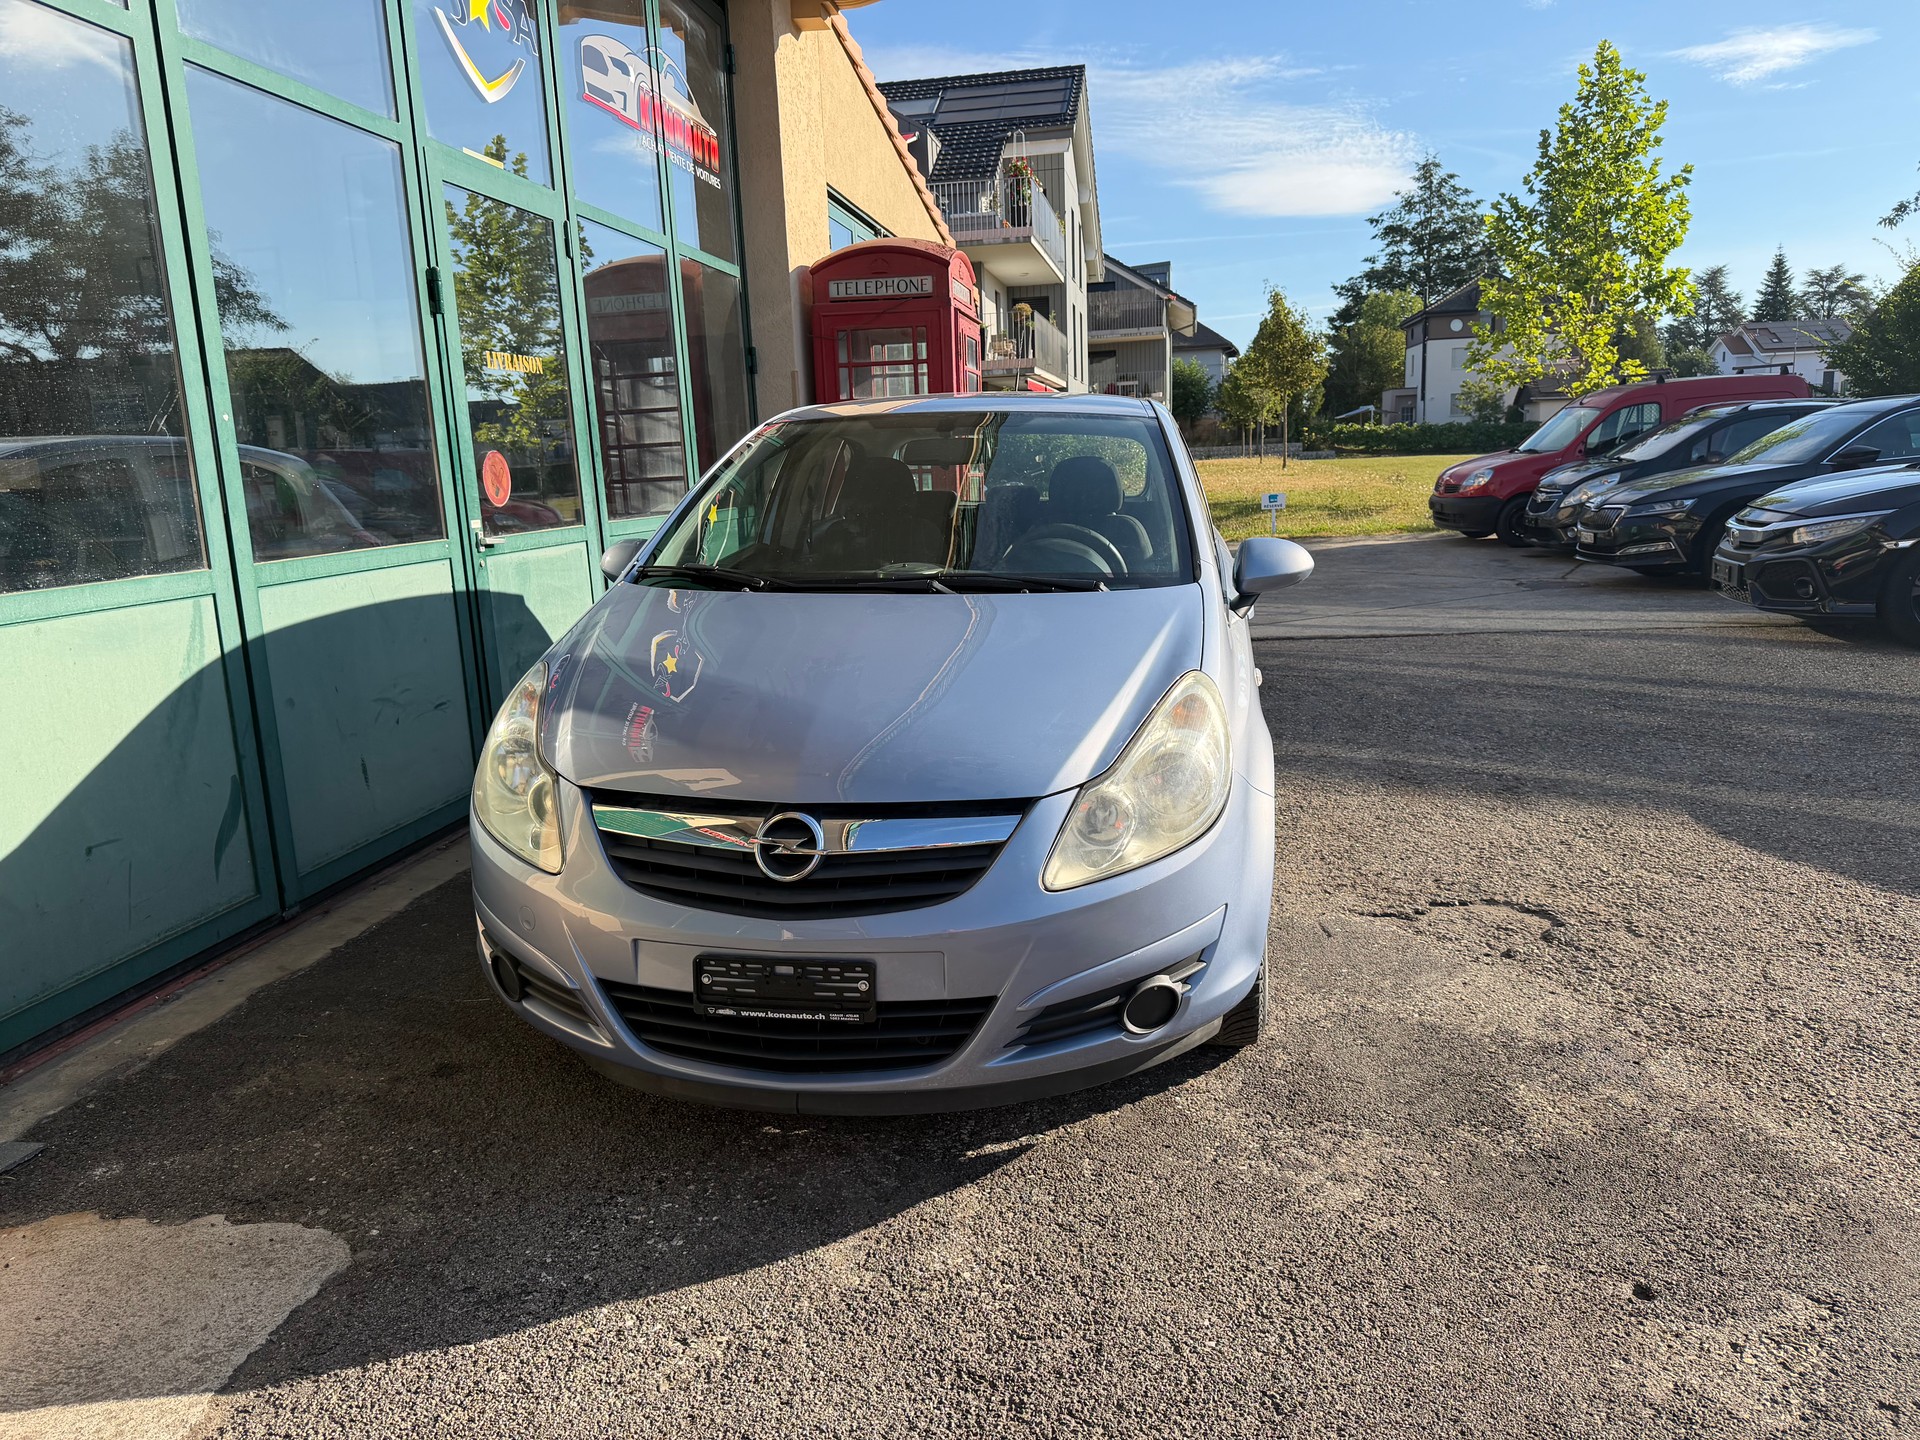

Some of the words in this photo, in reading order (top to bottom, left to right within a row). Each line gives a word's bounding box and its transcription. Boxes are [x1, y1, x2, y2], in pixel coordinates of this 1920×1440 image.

[686, 160, 696, 175] DE
[695, 166, 721, 189] VOITURES
[832, 277, 929, 297] TELEPHONE
[485, 350, 544, 375] LIVRAISON
[740, 1010, 826, 1020] www.konoauto.ch
